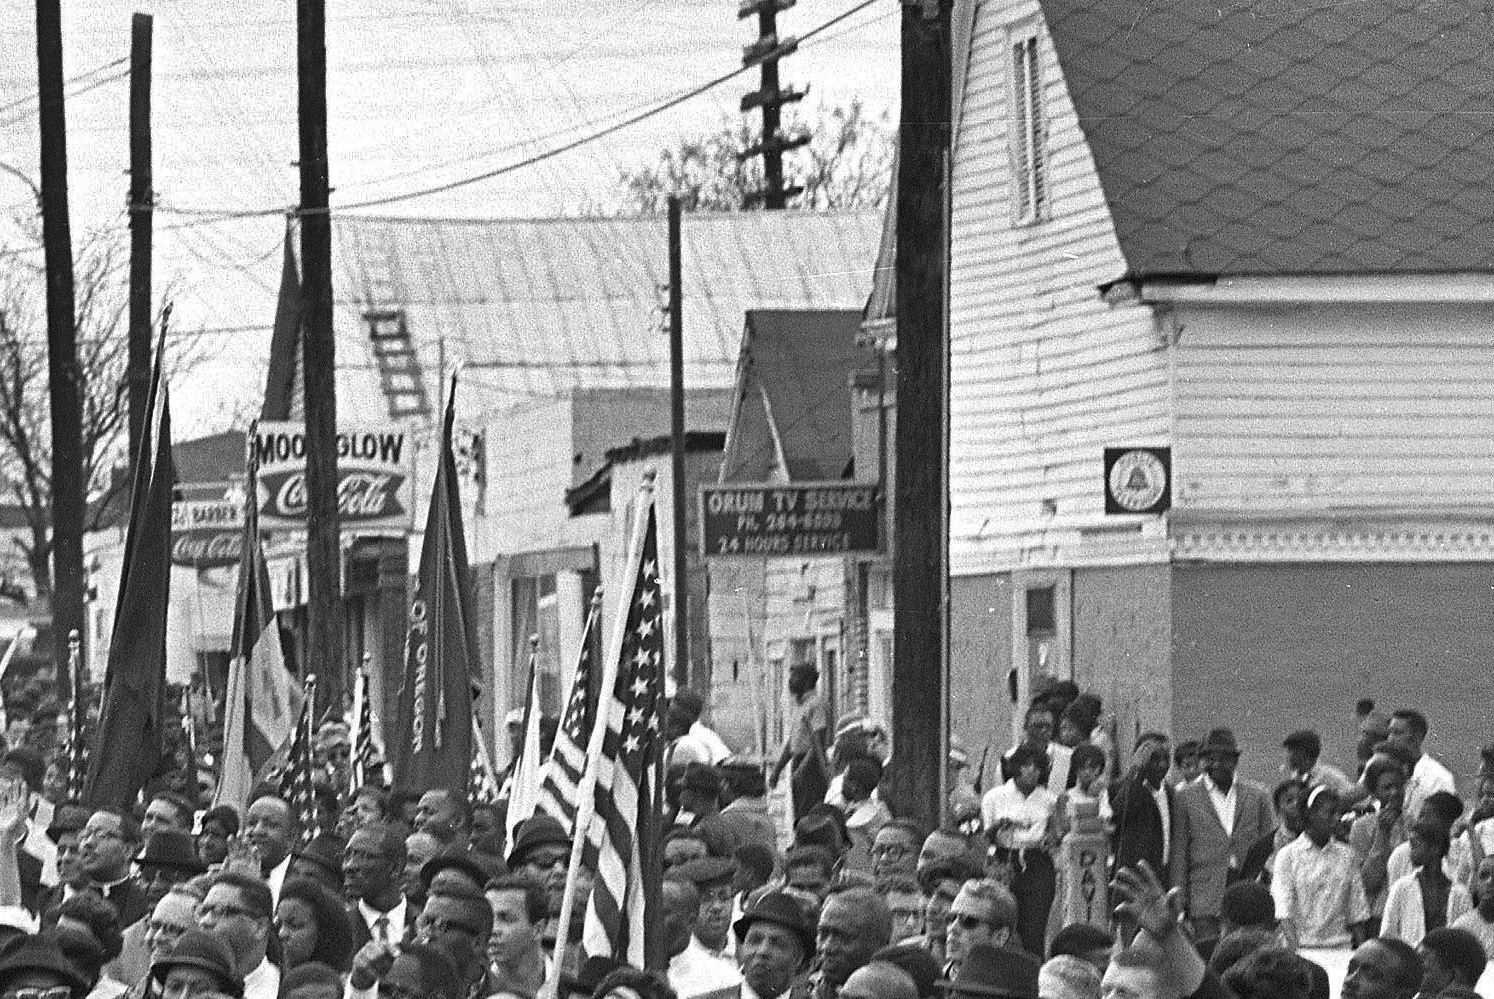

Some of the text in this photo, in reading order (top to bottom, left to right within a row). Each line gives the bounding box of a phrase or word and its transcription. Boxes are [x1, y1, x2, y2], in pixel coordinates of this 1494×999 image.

[255, 434, 404, 464] MOOGLOW
[772, 490, 798, 513] TV
[804, 489, 872, 512] SERVICE
[717, 535, 740, 554] 24
